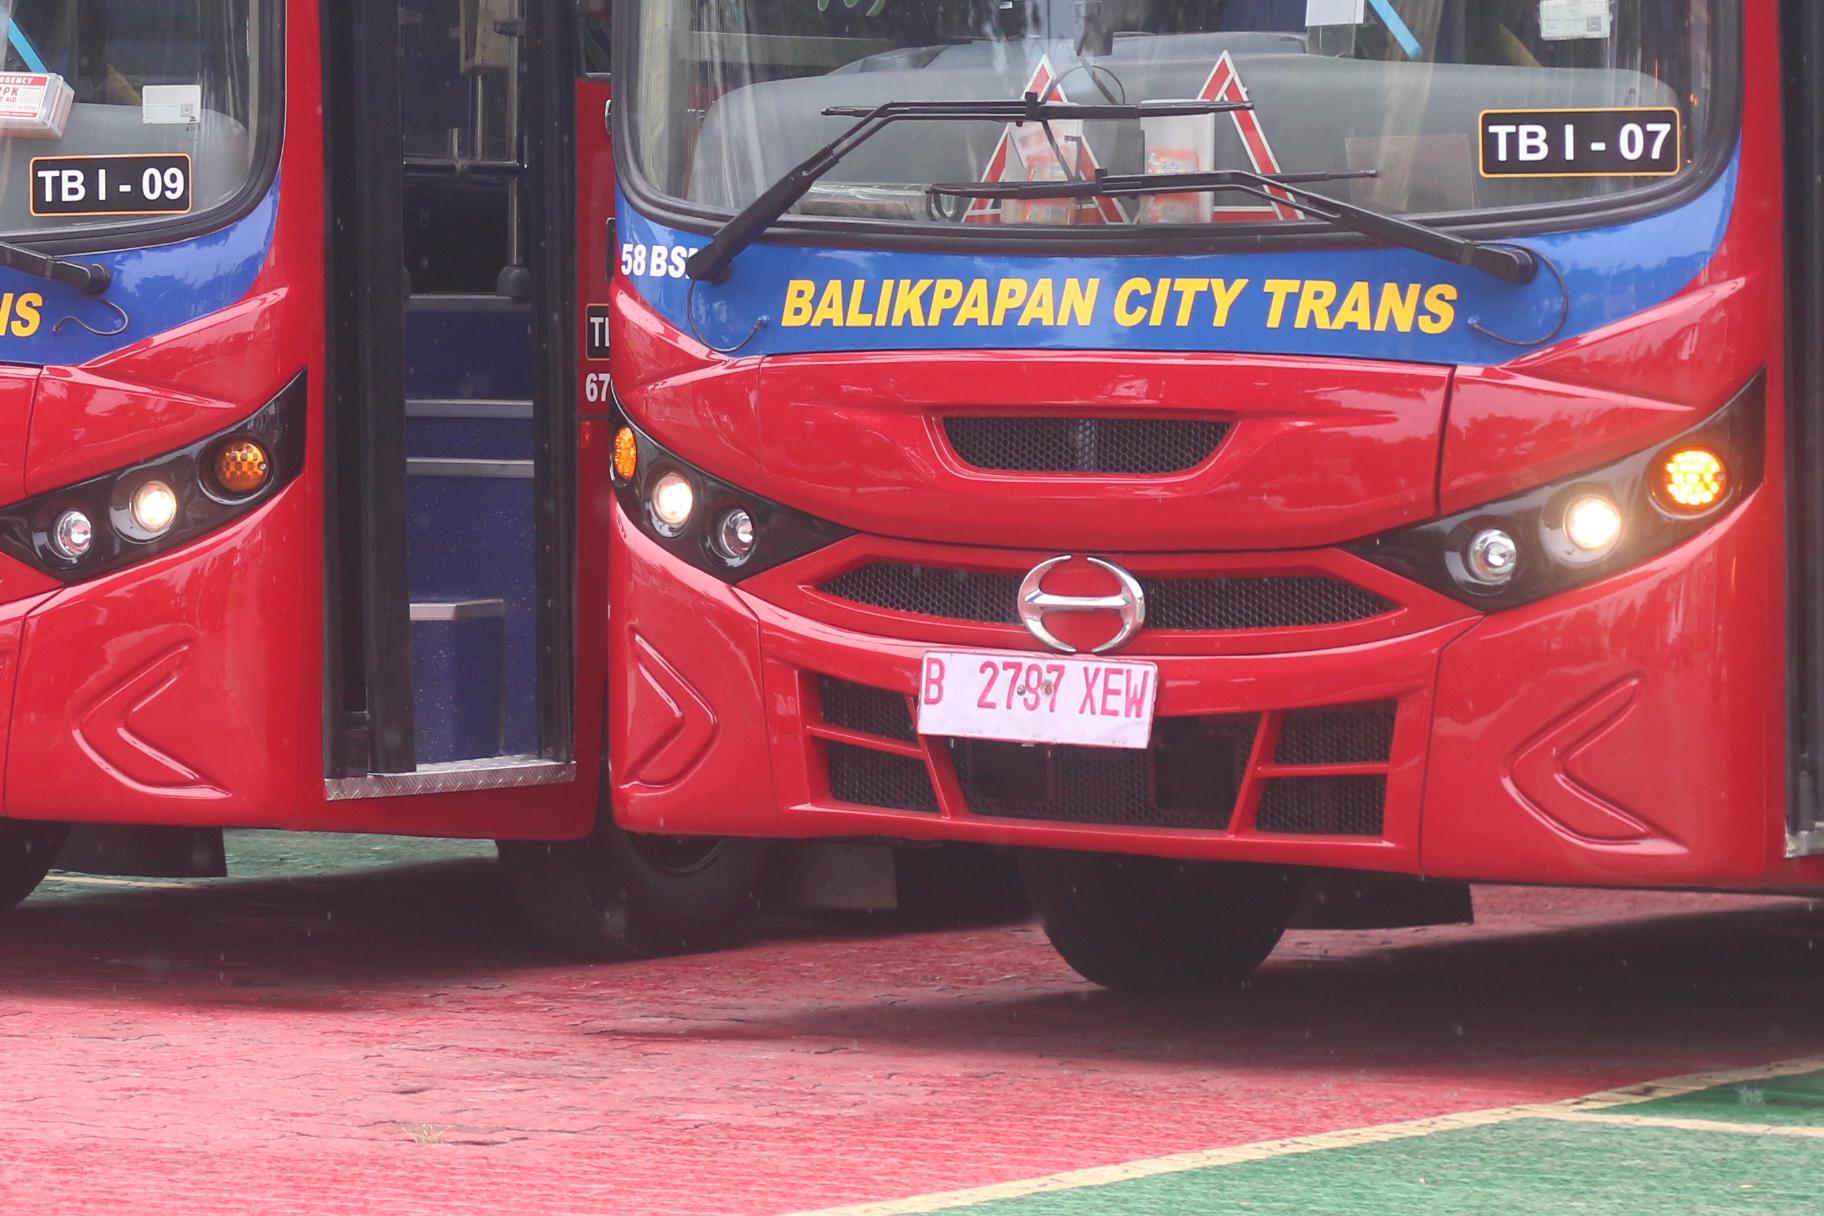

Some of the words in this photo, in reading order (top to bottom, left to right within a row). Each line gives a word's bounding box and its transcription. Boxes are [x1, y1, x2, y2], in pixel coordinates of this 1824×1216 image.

[1487, 124, 1549, 161] TB
[1618, 122, 1672, 161] 07
[37, 169, 87, 202] TB
[141, 167, 186, 200] 09
[621, 243, 647, 276] 58
[649, 245, 699, 280] BS
[781, 278, 1098, 328] BALIKPAPAN
[1114, 278, 1250, 328] CITY
[1262, 279, 1460, 335] TRANS
[585, 372, 611, 403] 67
[924, 657, 946, 706] B
[977, 660, 1066, 713] 2797
[1079, 665, 1150, 719] XEW
